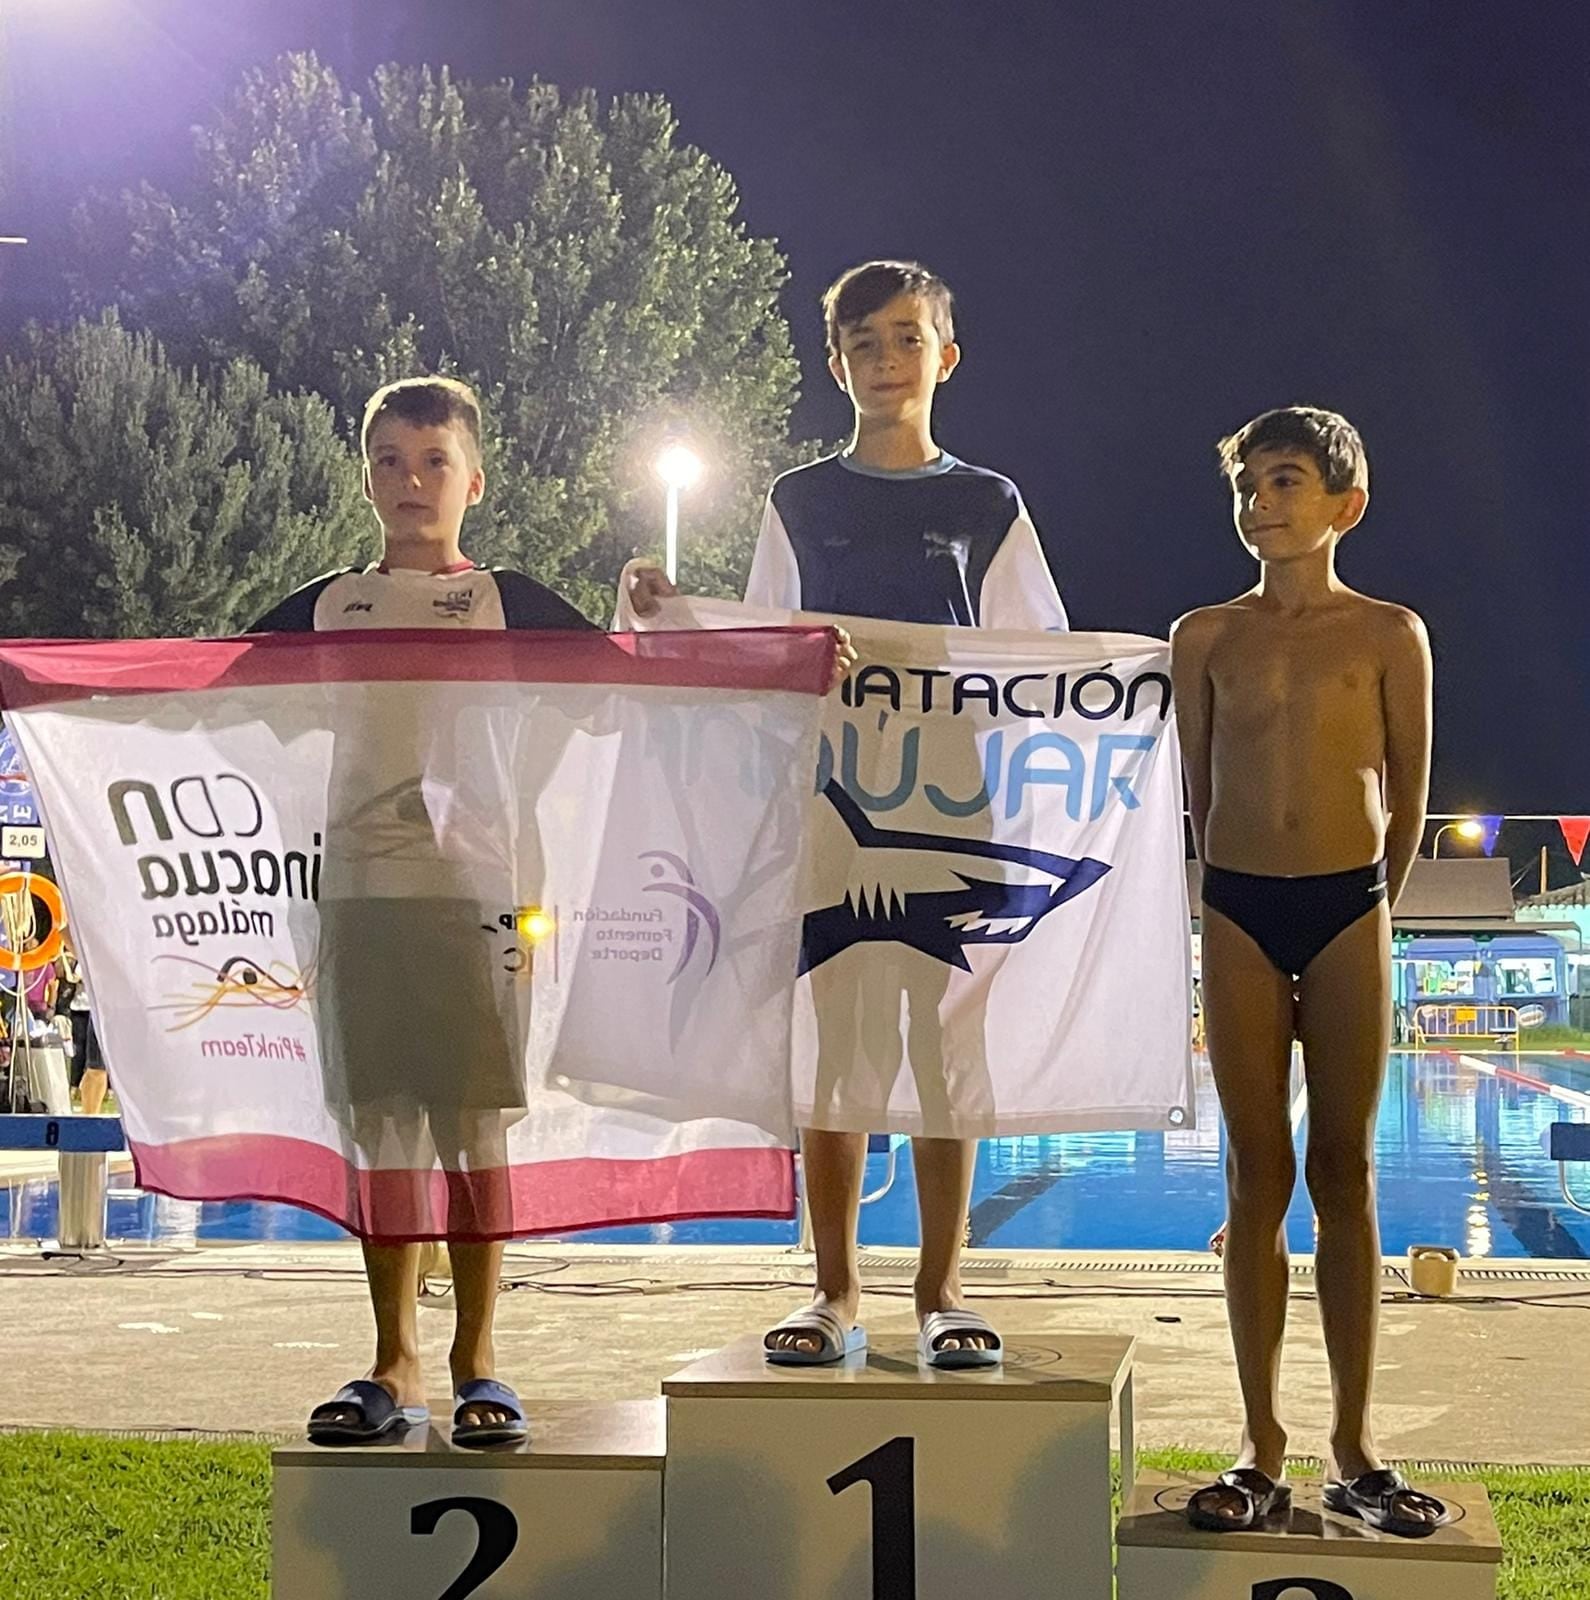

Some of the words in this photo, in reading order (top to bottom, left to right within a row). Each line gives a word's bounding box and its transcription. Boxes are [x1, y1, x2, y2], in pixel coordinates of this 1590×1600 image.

[9, 834, 38, 848] 2,05
[409, 1497, 520, 1600] 2
[827, 1436, 917, 1600] 1
